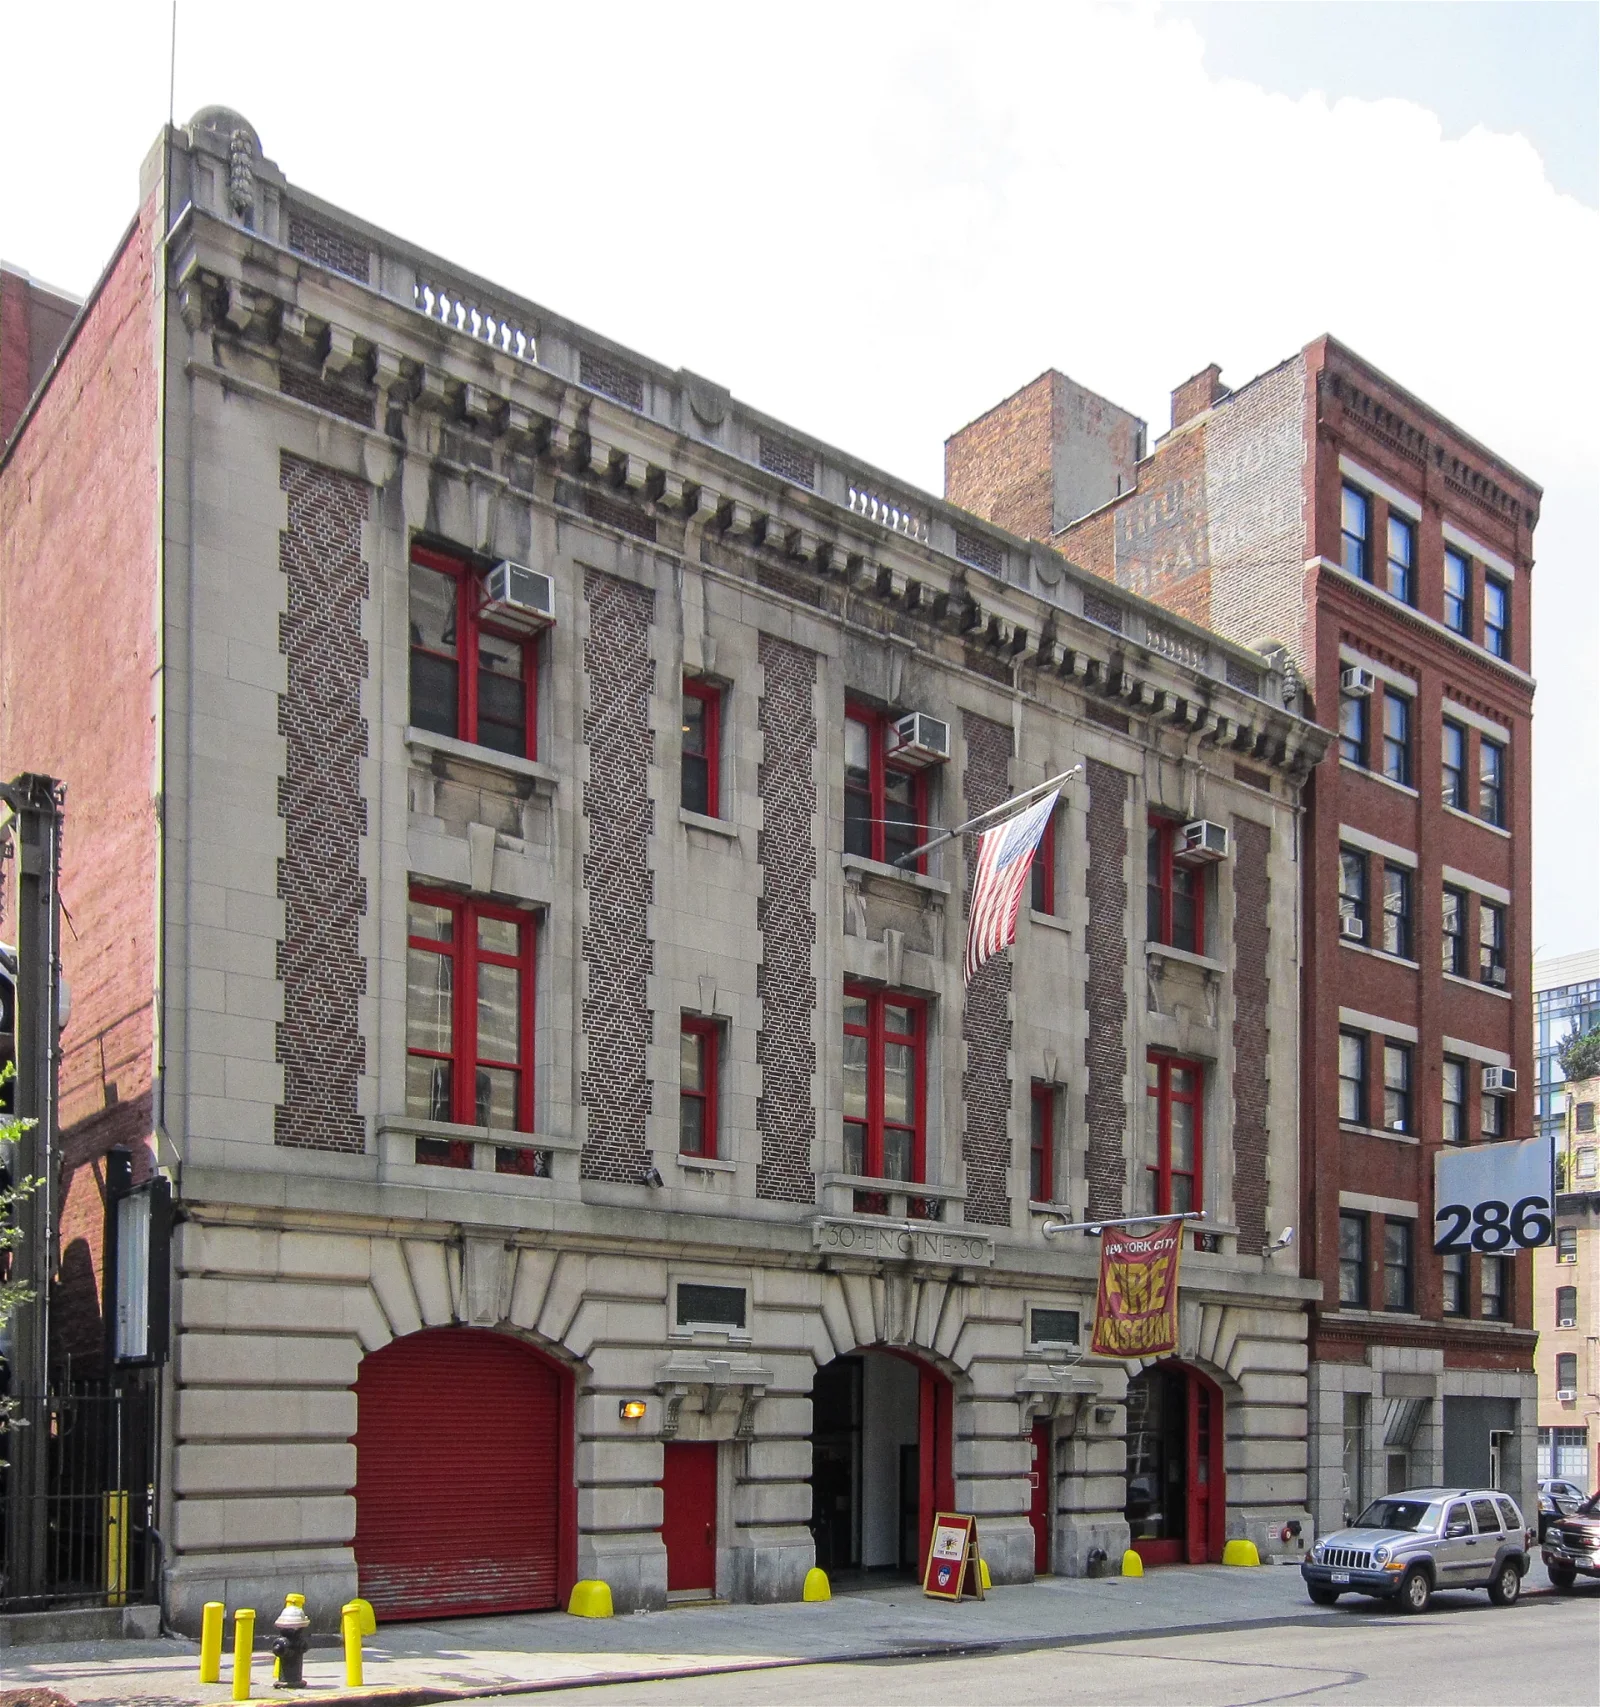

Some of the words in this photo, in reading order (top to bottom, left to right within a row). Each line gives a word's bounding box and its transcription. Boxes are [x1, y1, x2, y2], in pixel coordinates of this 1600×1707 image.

[827, 1225, 855, 1247] 30
[865, 1229, 951, 1258] ENGINE
[959, 1240, 984, 1260] 30
[1433, 1196, 1552, 1254] 286
[1123, 1241, 1152, 1253] YORK
[1153, 1238, 1177, 1250] CITY
[1096, 1312, 1171, 1350] MUSEUM
